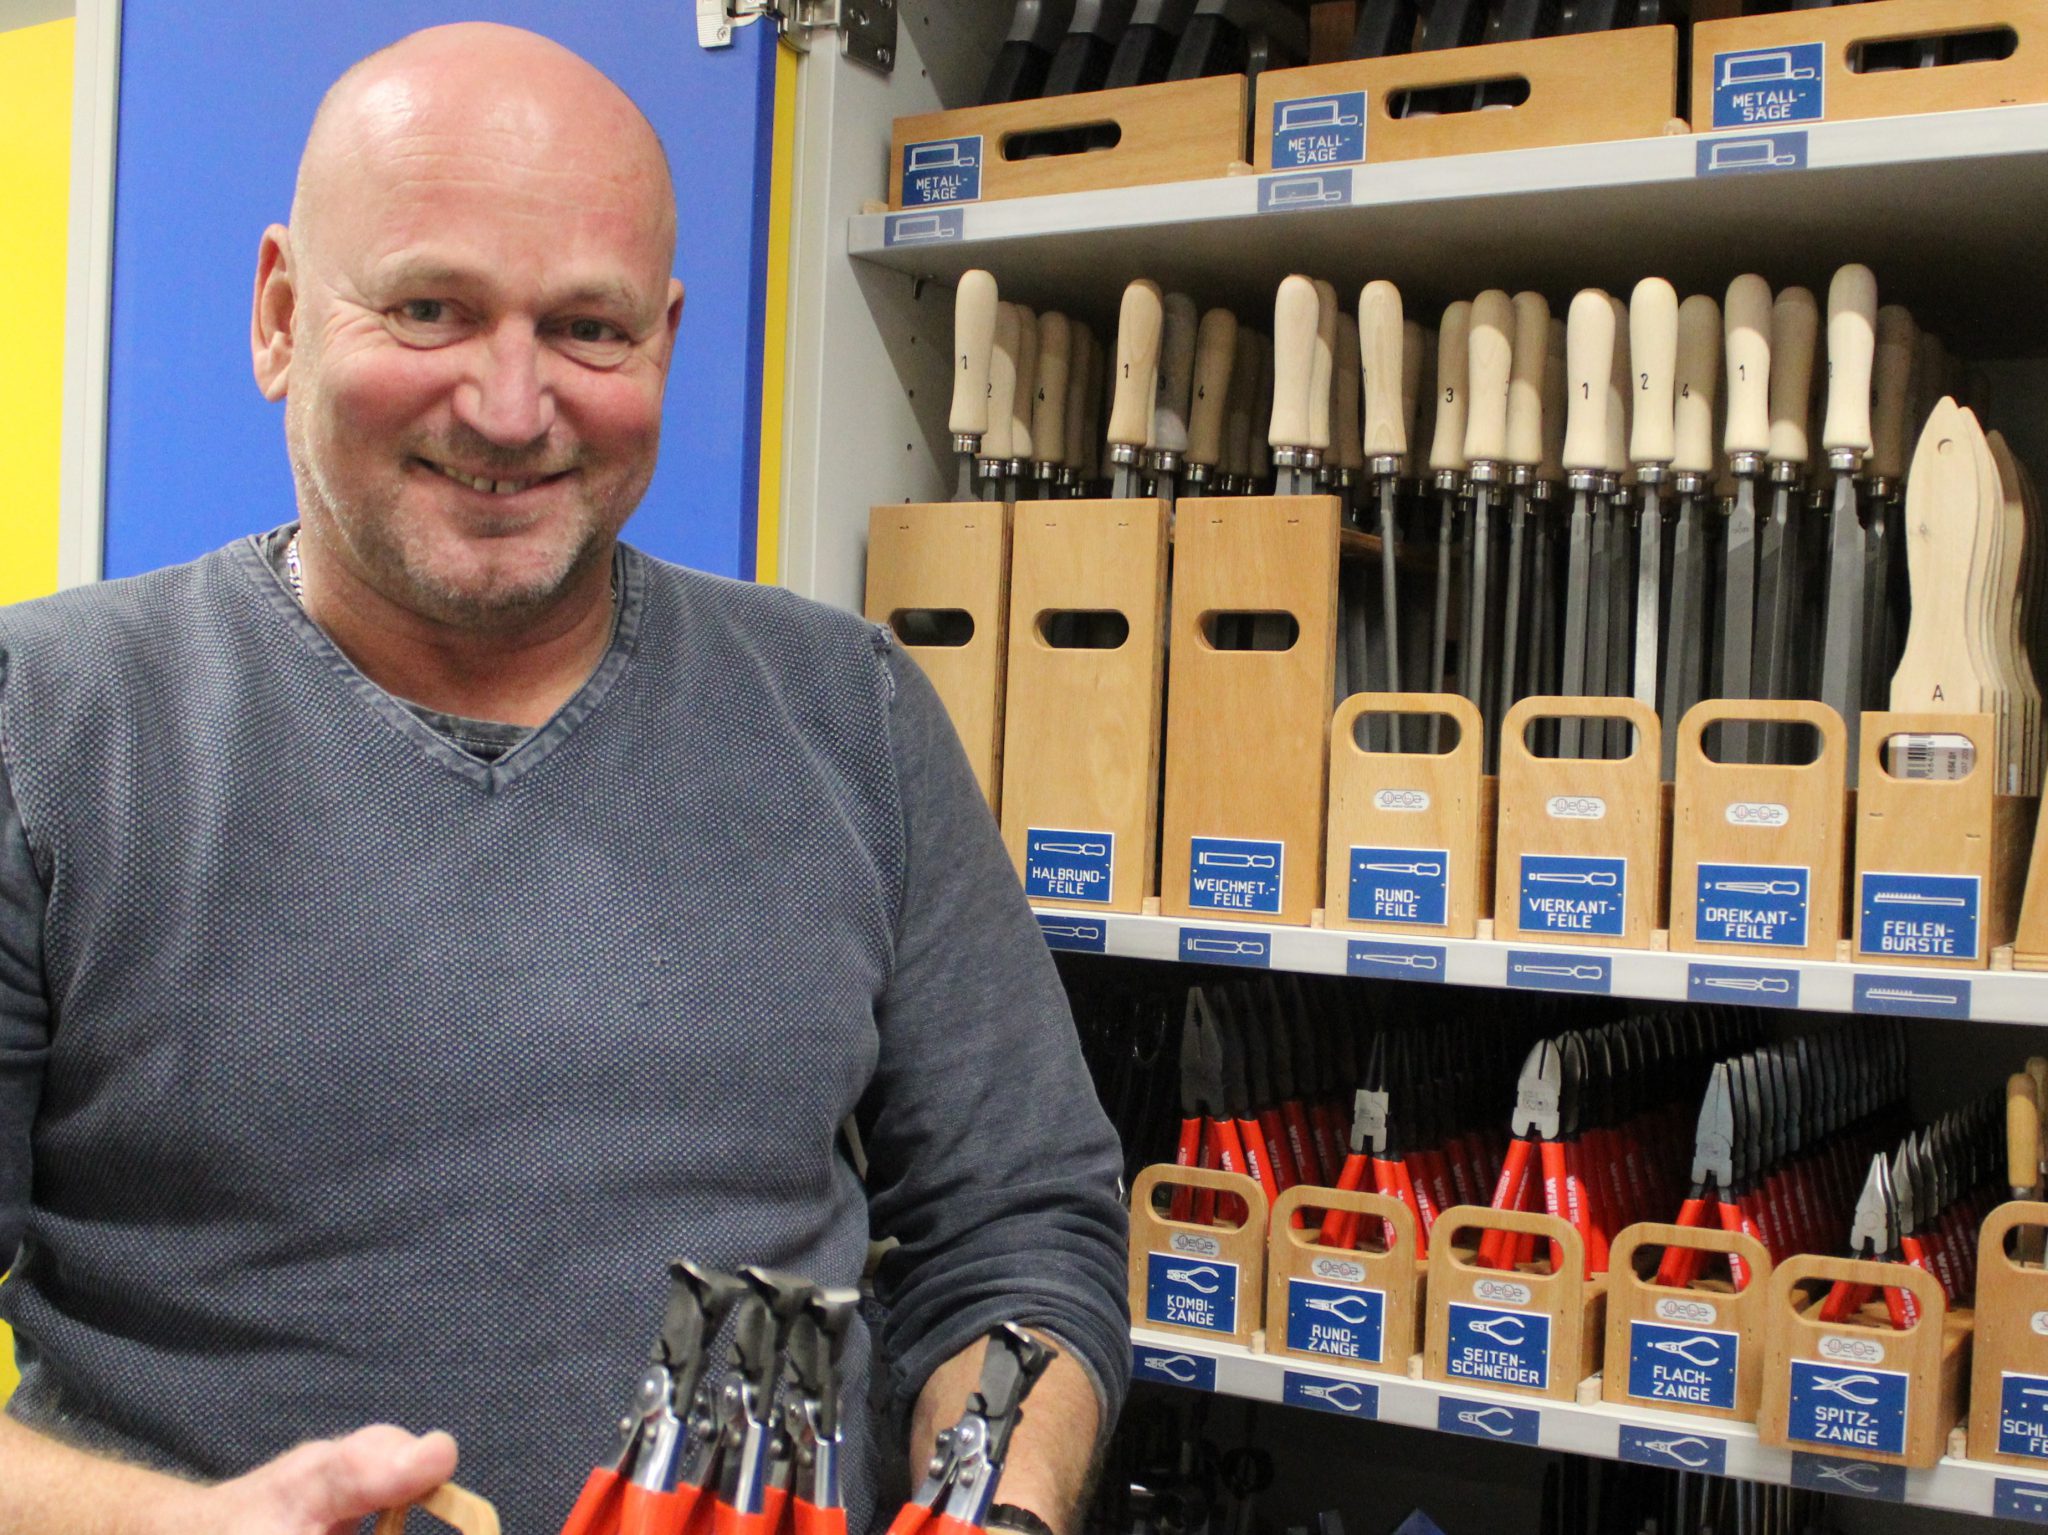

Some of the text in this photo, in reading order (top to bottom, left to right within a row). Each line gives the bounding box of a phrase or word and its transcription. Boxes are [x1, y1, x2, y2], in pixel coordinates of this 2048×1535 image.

[1733, 89, 1806, 108] METALL-
[1288, 134, 1350, 152] METALL-
[916, 174, 968, 190] METALL-
[1124, 363, 1130, 379] 1
[1739, 364, 1746, 381] 1
[1640, 373, 1649, 390] 2
[1445, 387, 1454, 403] 3
[1582, 382, 1589, 400] 1
[1682, 383, 1690, 399] 4
[1931, 684, 1944, 701] A
[1032, 866, 1106, 883] HALBRUND-
[1048, 880, 1085, 895] FEILE
[1194, 877, 1276, 895] WEICHMET.-
[1214, 892, 1253, 907] FEILE
[1375, 887, 1420, 903] RUND-
[1375, 902, 1418, 917] FEILE
[1528, 897, 1616, 914] VIERKANT-
[1547, 913, 1592, 929] FEILE
[1706, 907, 1797, 925] DREIKANT-
[1725, 923, 1773, 940] FEILE
[1883, 920, 1954, 937] FEILEN-
[1167, 1294, 1215, 1312] KOMBI-
[1167, 1307, 1214, 1326] ZANGE
[1312, 1324, 1358, 1342] RUND-
[1308, 1337, 1359, 1357] ZANGE
[1463, 1347, 1526, 1367] SEITEN-
[1451, 1359, 1539, 1384] SCHNEIDER
[1653, 1365, 1712, 1384] FLACH-
[1652, 1381, 1710, 1402] ZANGE
[1815, 1406, 1879, 1427] SPITZ-
[1815, 1423, 1879, 1446] ZANGE
